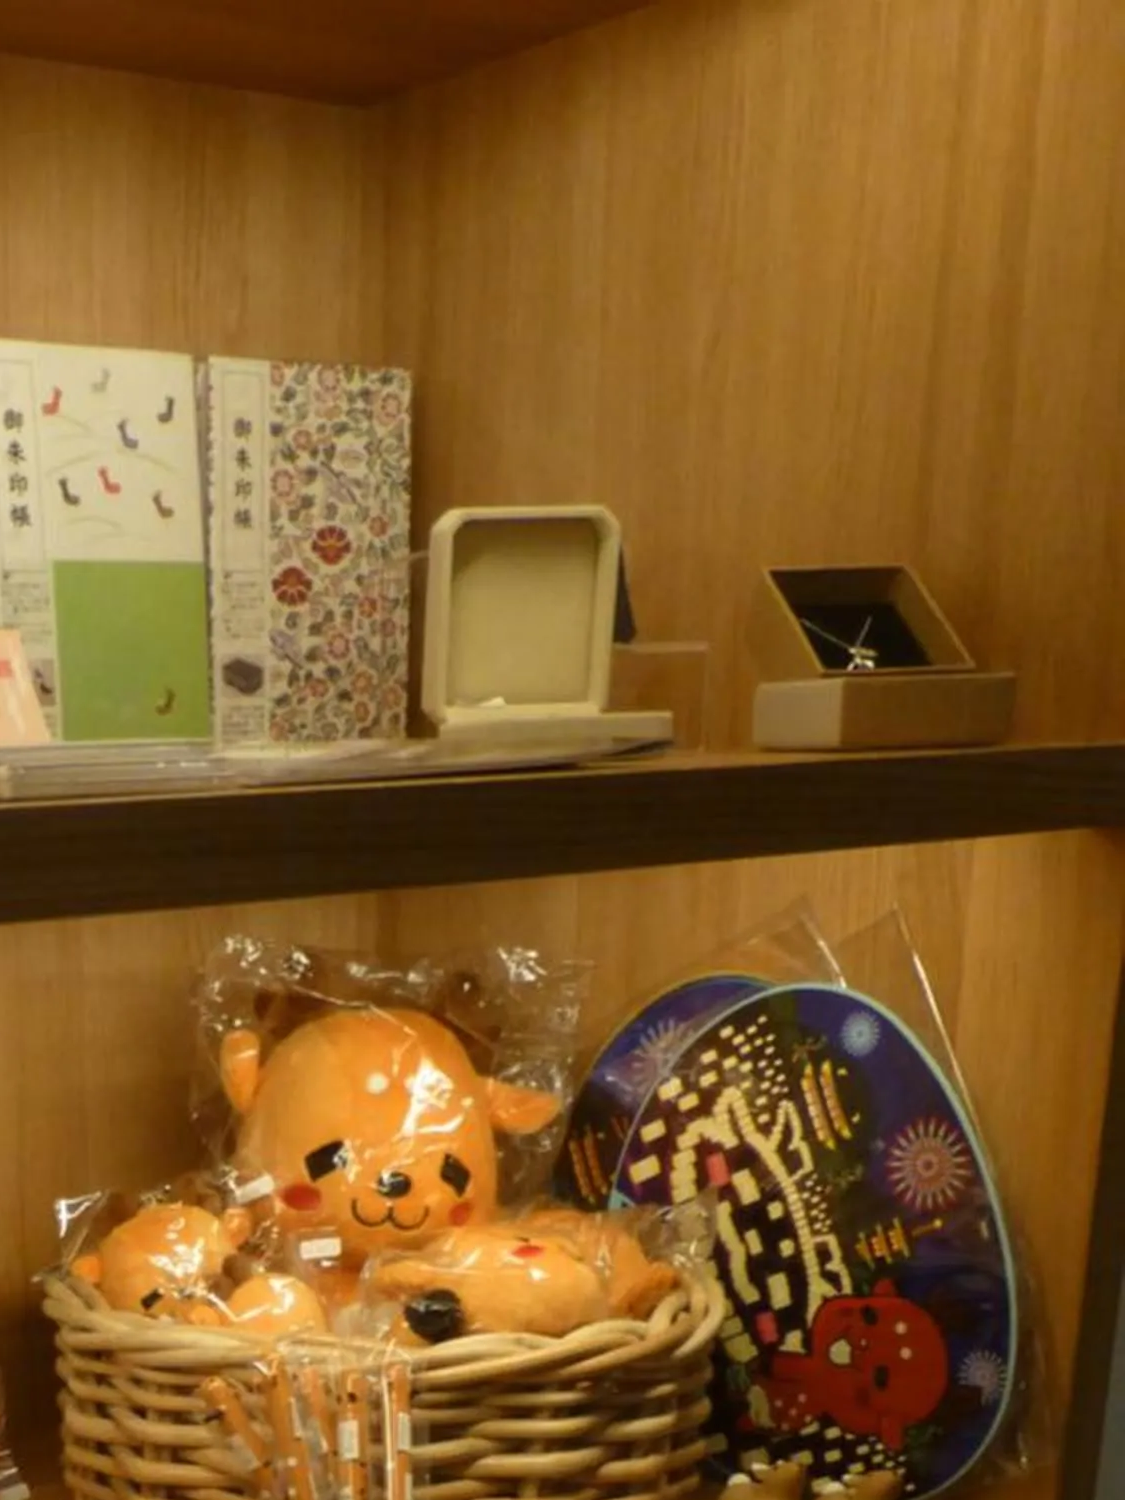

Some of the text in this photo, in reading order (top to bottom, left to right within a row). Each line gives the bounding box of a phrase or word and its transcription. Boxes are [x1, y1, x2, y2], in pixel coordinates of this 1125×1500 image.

[3, 408, 32, 528] 御朱印帳
[233, 417, 254, 530] 御朱印帳
